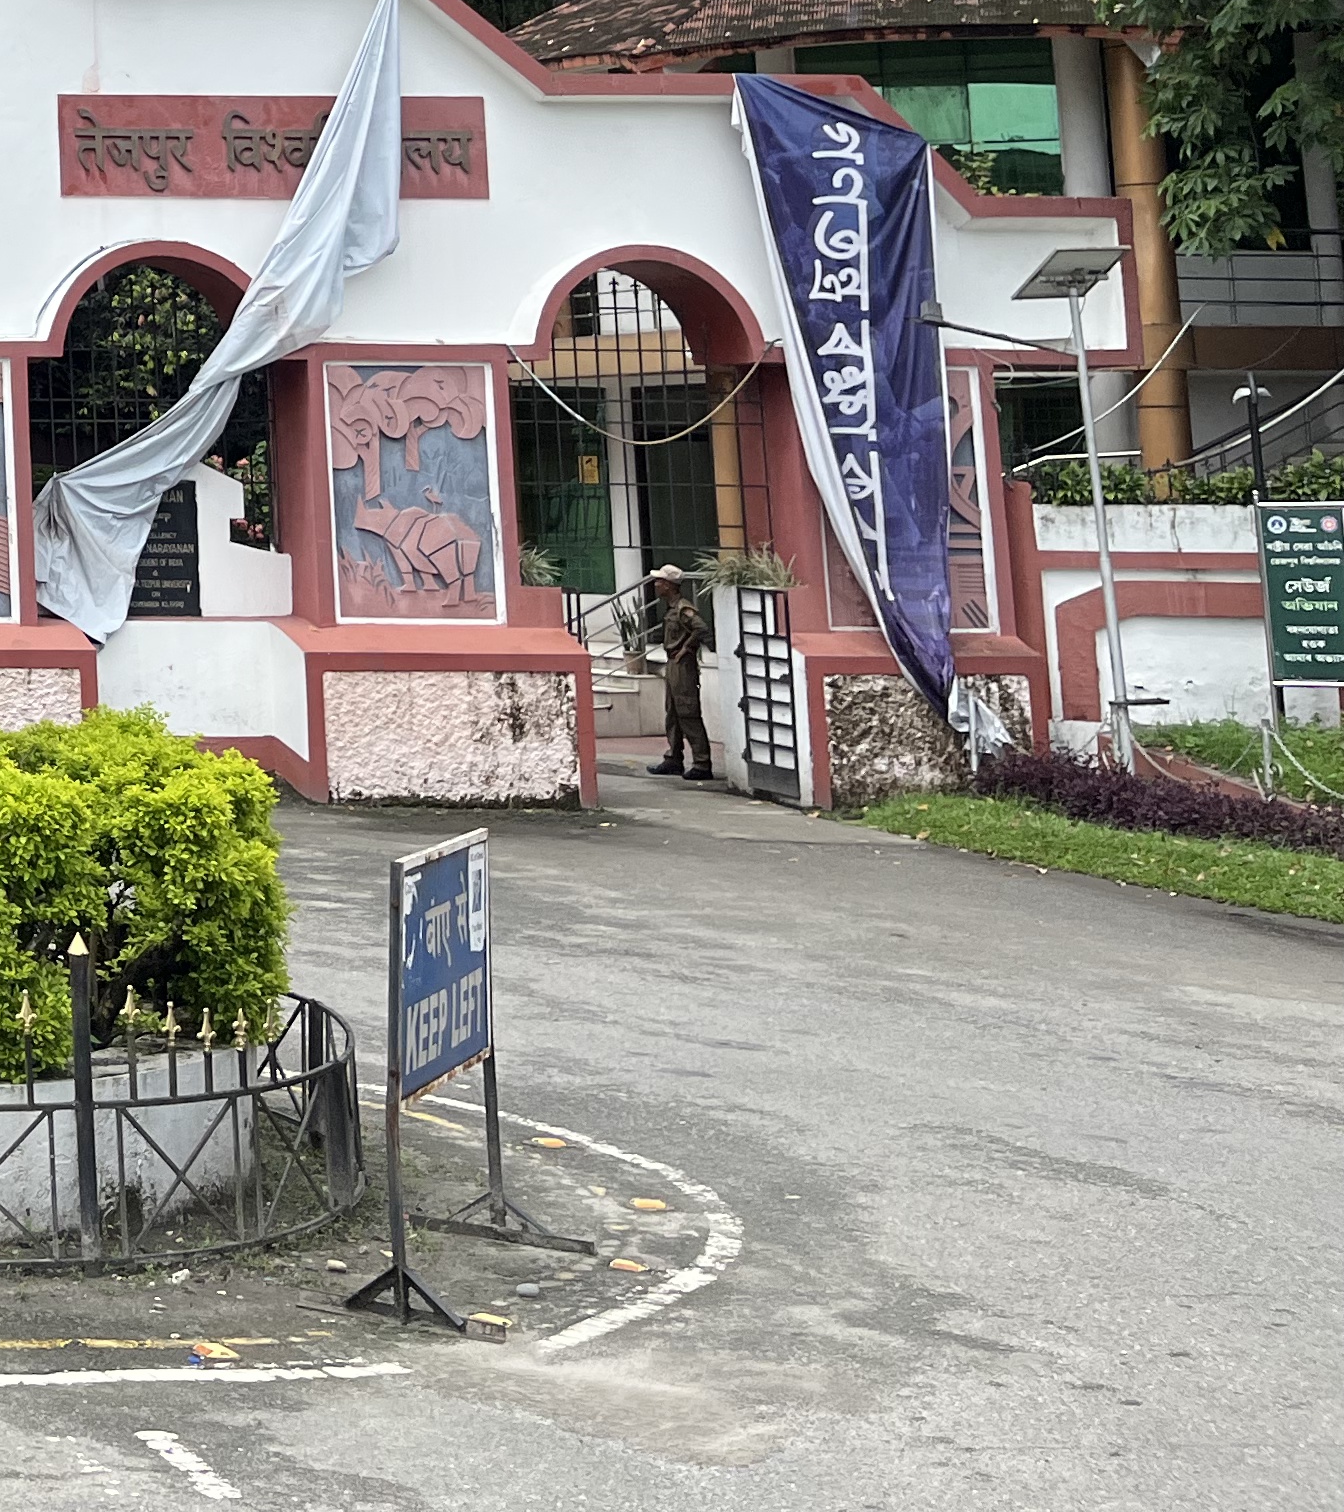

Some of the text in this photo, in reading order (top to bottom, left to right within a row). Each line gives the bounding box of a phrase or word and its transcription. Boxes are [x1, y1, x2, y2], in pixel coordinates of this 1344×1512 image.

[74, 108, 193, 192] तेजपुर
[1281, 597, 1338, 612] অভিযান
[406, 966, 483, 1076] KEEP LEFT
